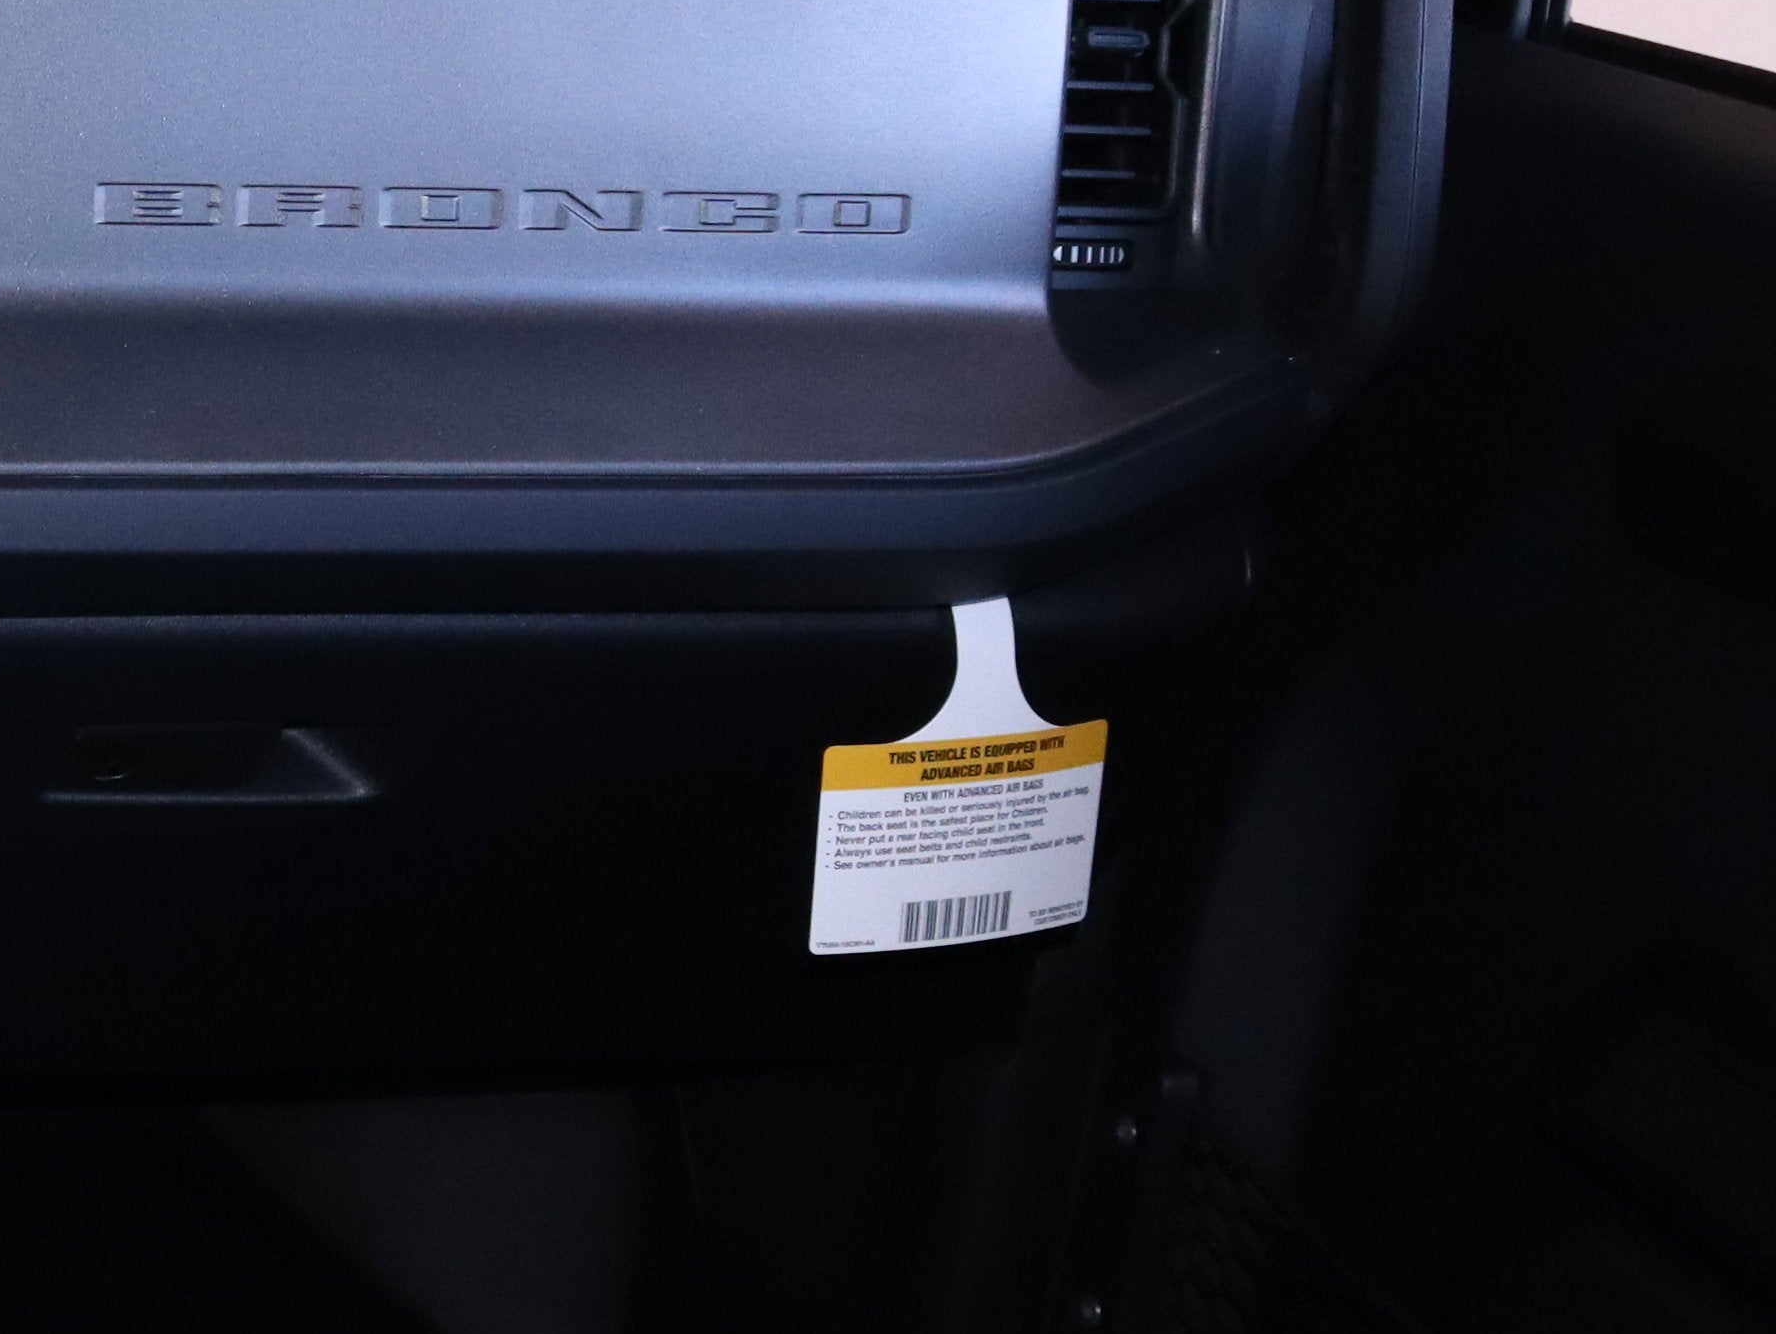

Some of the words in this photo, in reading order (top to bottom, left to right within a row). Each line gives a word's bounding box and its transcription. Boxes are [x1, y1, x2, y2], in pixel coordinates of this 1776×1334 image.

[93, 181, 912, 235] BRONCO
[889, 752, 916, 764] THIS
[920, 747, 967, 763] VEHICLE
[970, 747, 981, 759] IS
[984, 741, 1038, 756] EQUIPPED
[1040, 735, 1065, 751] WITH
[920, 764, 982, 781] ADVANCED
[985, 762, 1004, 775] AIR
[1008, 759, 1036, 773] BAGS
[904, 791, 928, 803] EVEN
[931, 789, 954, 801] WITH
[958, 785, 1004, 798] ADVANCED
[1006, 782, 1021, 793] AIR
[1022, 779, 1044, 791] BAGS
[837, 809, 882, 821] Children
[884, 810, 902, 818] can
[906, 807, 917, 817] be
[920, 805, 946, 816] killed
[949, 805, 959, 813] or
[961, 801, 1003, 813] seriously
[1006, 795, 1036, 808] injured
[1037, 794, 1048, 805] by
[1048, 791, 1062, 801] the
[835, 835, 866, 845] Never
[869, 835, 886, 845] put
[896, 833, 917, 842] rear
[920, 831, 951, 841] facing
[952, 828, 974, 837] child
[976, 825, 996, 835] seat
[1008, 821, 1022, 831] the
[837, 823, 856, 833] The
[859, 821, 883, 831] back
[886, 821, 907, 830] seat
[910, 821, 918, 829] is
[922, 818, 936, 827] the
[940, 816, 967, 826] safest
[834, 848, 872, 859] Always
[896, 845, 917, 855] seat
[920, 843, 942, 853] belts
[946, 841, 964, 849] and
[966, 837, 988, 848] child
[834, 861, 853, 870] See
[856, 859, 896, 869] owner's
[898, 856, 934, 867] manual
[937, 854, 950, 863] for
[952, 852, 976, 861] more
[978, 845, 1028, 859] information
[1030, 841, 1054, 852] about
